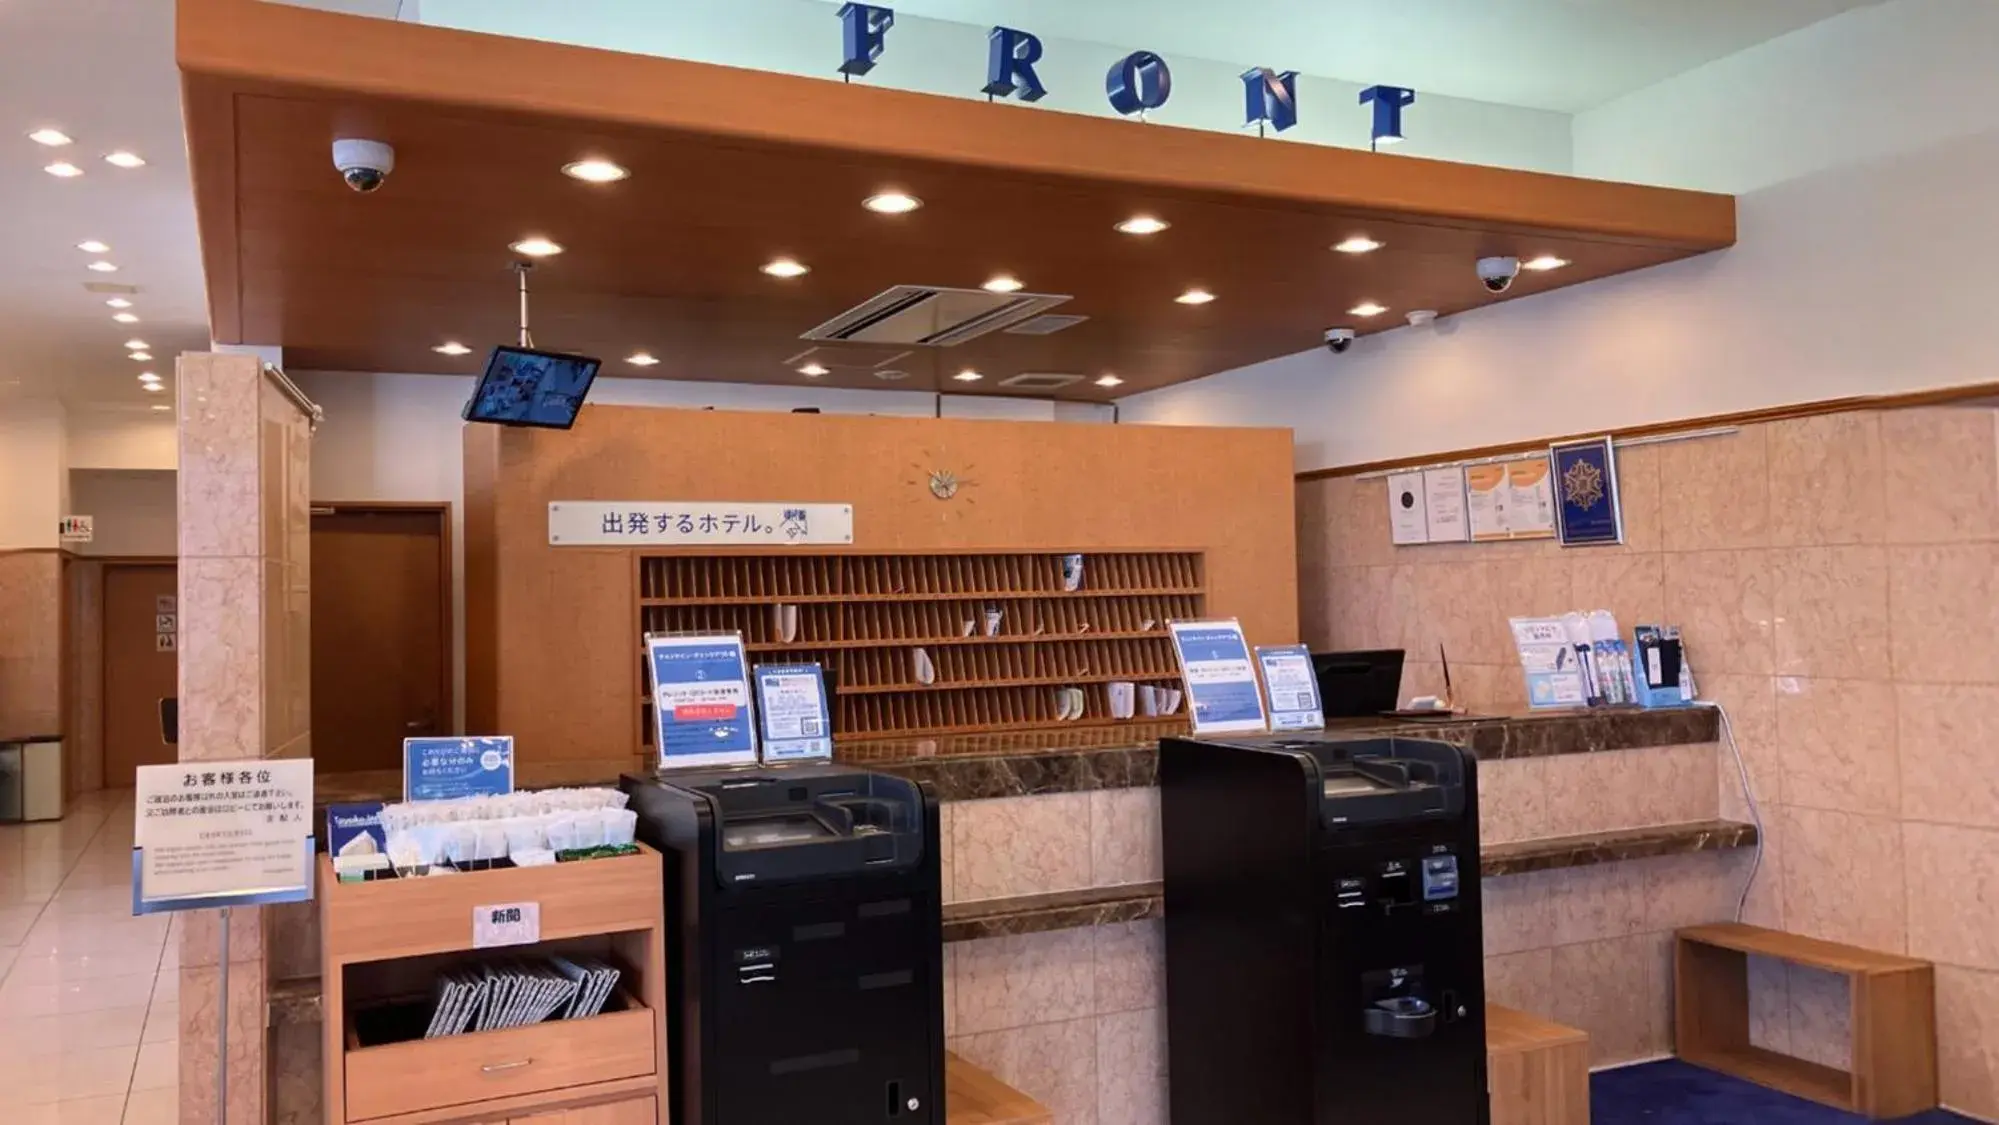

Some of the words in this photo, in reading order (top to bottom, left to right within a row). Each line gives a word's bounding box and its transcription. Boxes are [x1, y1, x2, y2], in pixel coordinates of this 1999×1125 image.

[835, 1, 1415, 144] FRONT
[602, 511, 774, 535] 出発するホテル。
[183, 769, 272, 787] お客様各位
